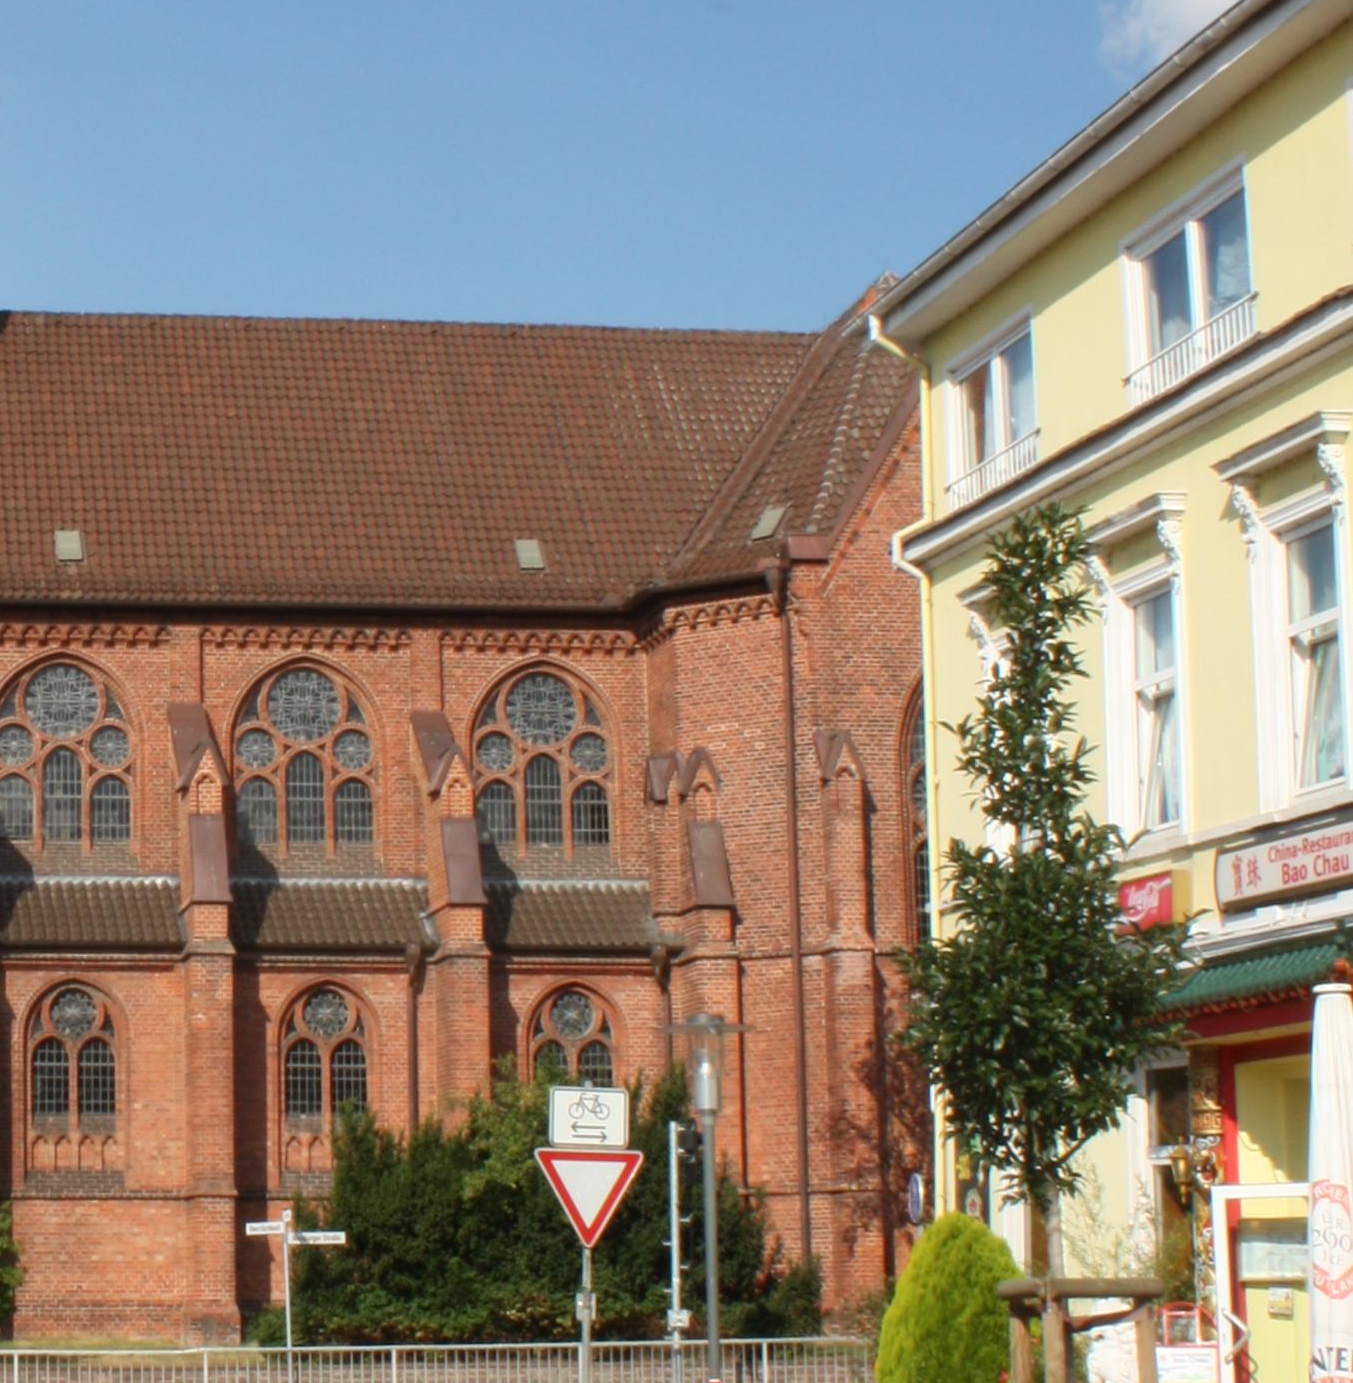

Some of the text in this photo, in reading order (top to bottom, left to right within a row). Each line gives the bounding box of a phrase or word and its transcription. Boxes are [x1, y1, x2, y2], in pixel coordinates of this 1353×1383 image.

[1268, 832, 1353, 863] China-Restaura
[1281, 853, 1349, 885] Bao Chau
